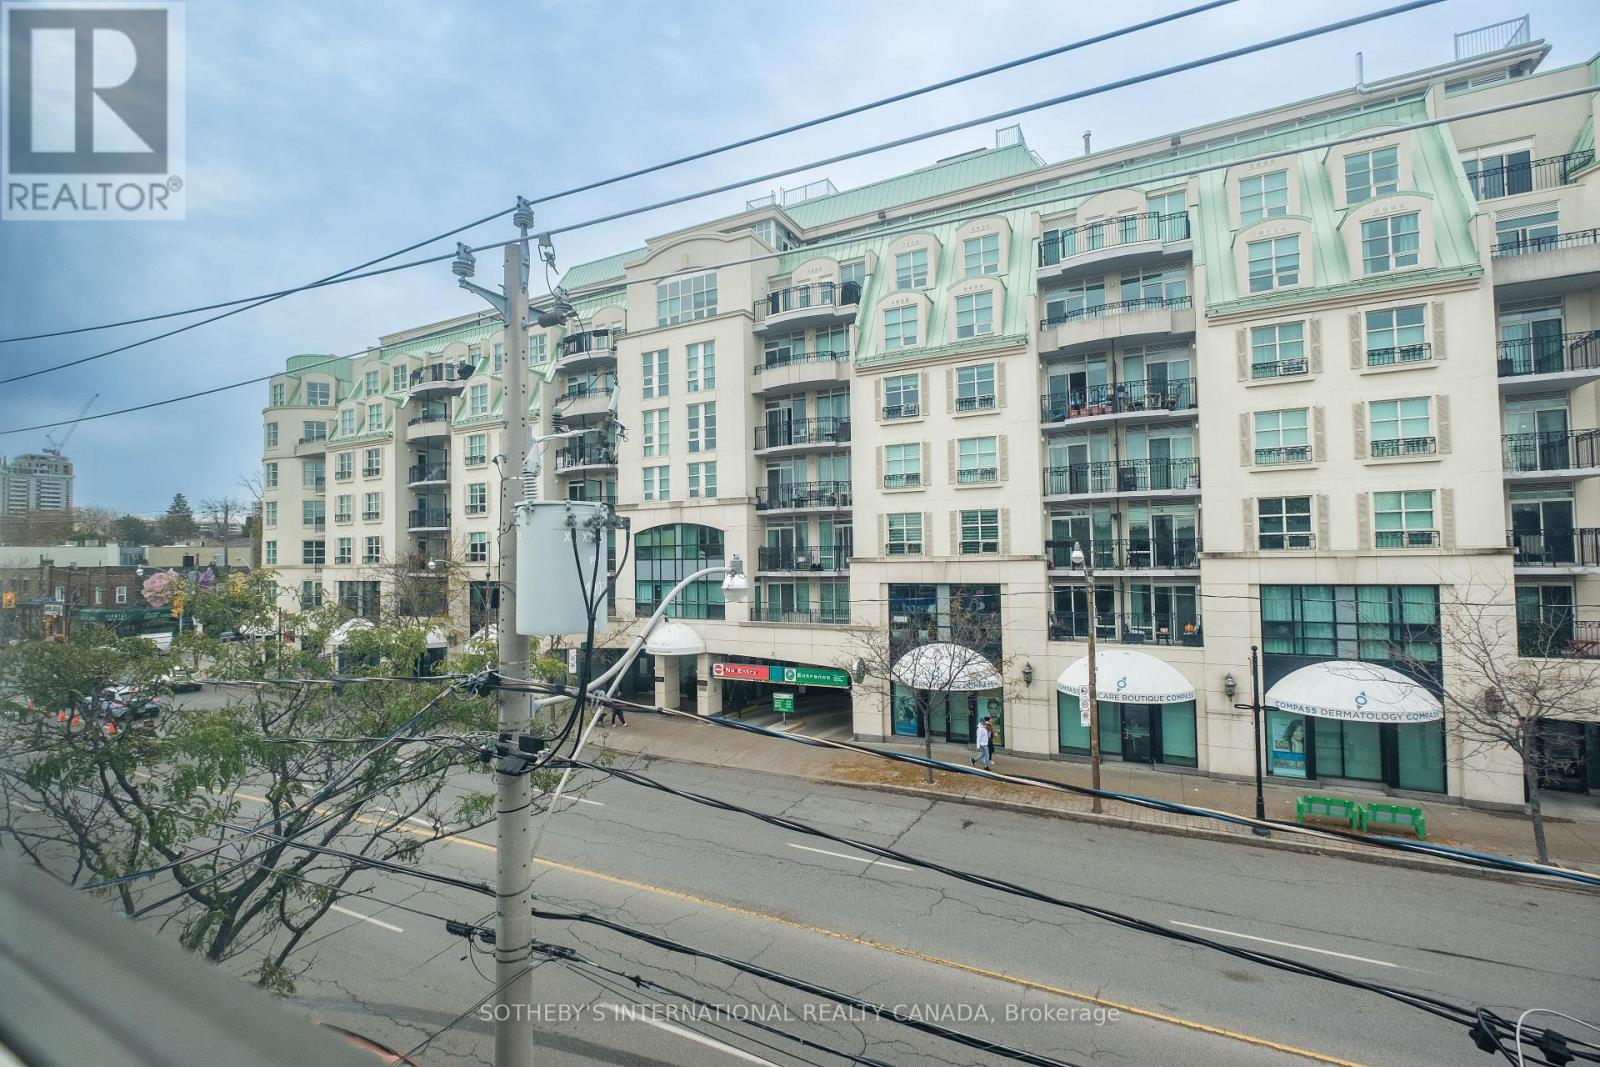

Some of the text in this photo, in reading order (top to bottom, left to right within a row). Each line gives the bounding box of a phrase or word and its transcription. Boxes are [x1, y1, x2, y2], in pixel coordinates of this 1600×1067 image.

[737, 668, 757, 676] Entry
[796, 672, 831, 680] Entrance
[1098, 692, 1120, 701] CARE
[1122, 694, 1164, 702] BOUTIQUE
[1275, 700, 1317, 714] COMPASS
[1320, 708, 1404, 721] DERMATOLOGY
